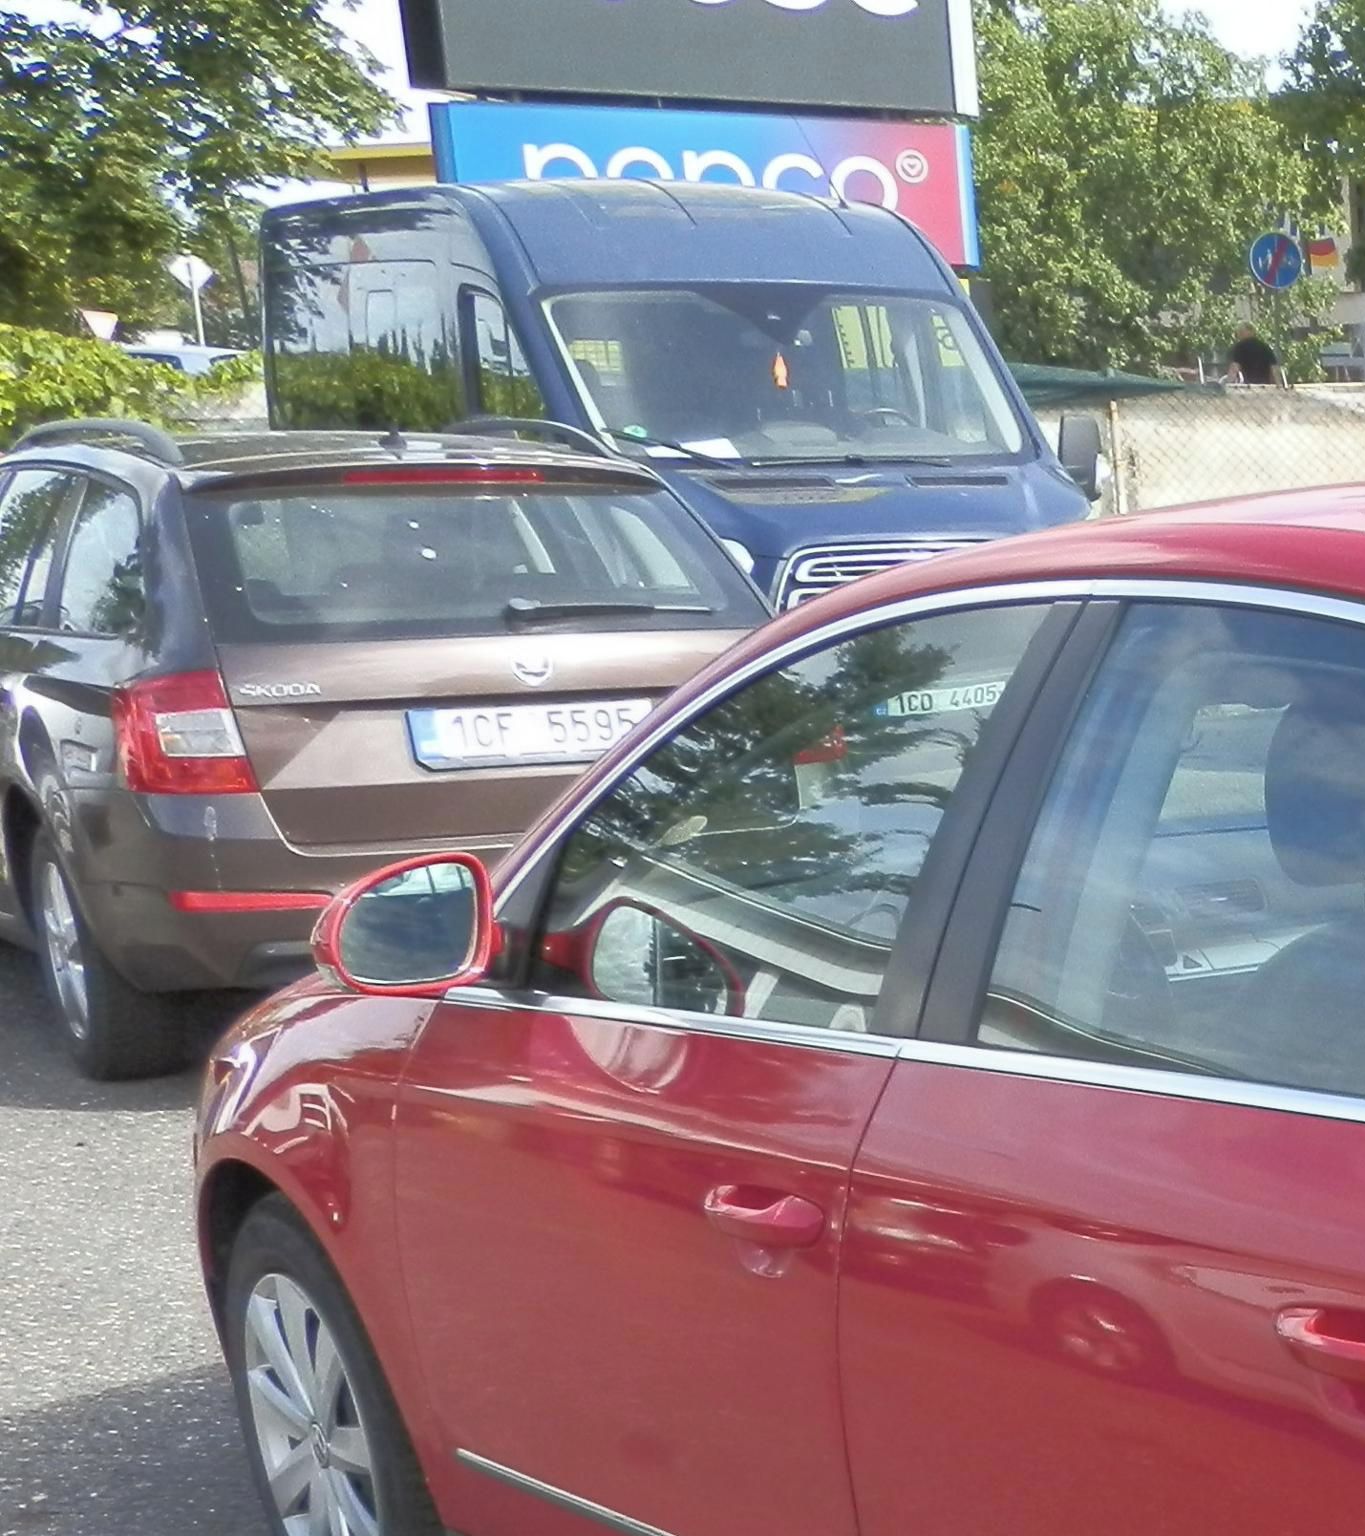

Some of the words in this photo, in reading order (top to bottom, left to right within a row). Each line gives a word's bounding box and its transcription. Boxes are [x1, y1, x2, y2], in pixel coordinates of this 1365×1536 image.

[949, 683, 998, 708] 4405
[452, 713, 512, 753] 1CF
[547, 707, 638, 743] 5595
